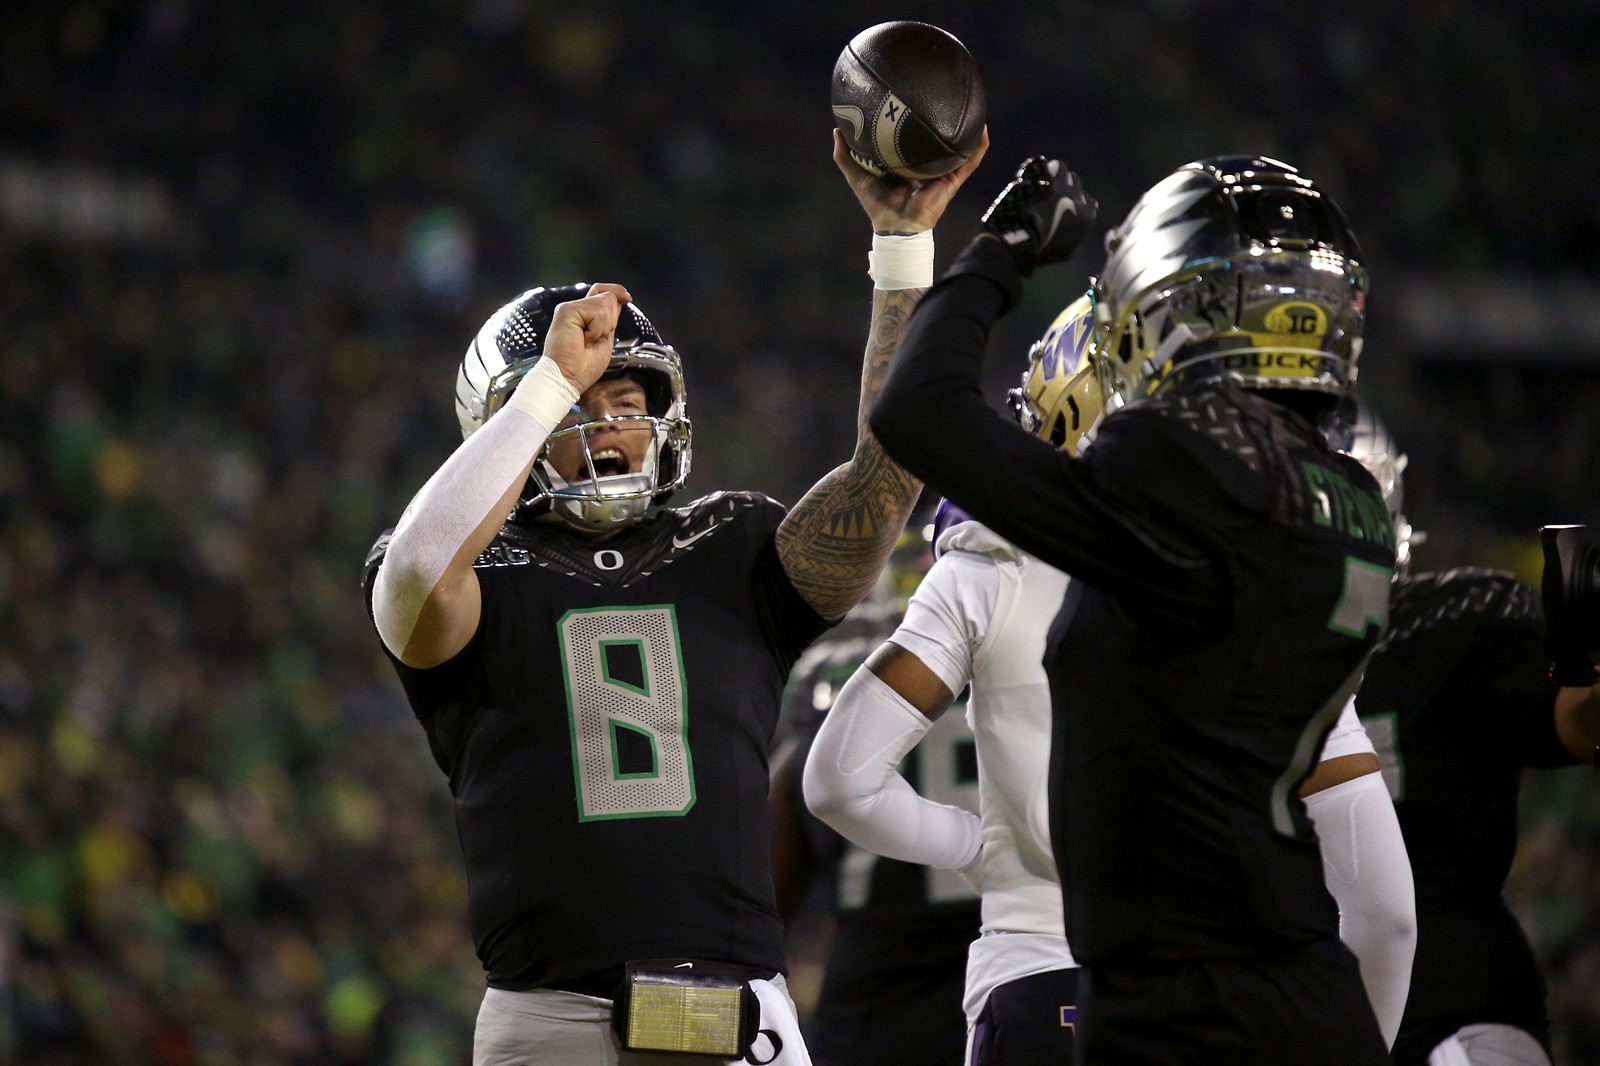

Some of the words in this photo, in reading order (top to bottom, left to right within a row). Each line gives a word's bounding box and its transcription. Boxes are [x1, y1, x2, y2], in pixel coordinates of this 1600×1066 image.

[593, 549, 625, 570] O
[556, 603, 697, 823] 8
[1268, 554, 1394, 838] 7
